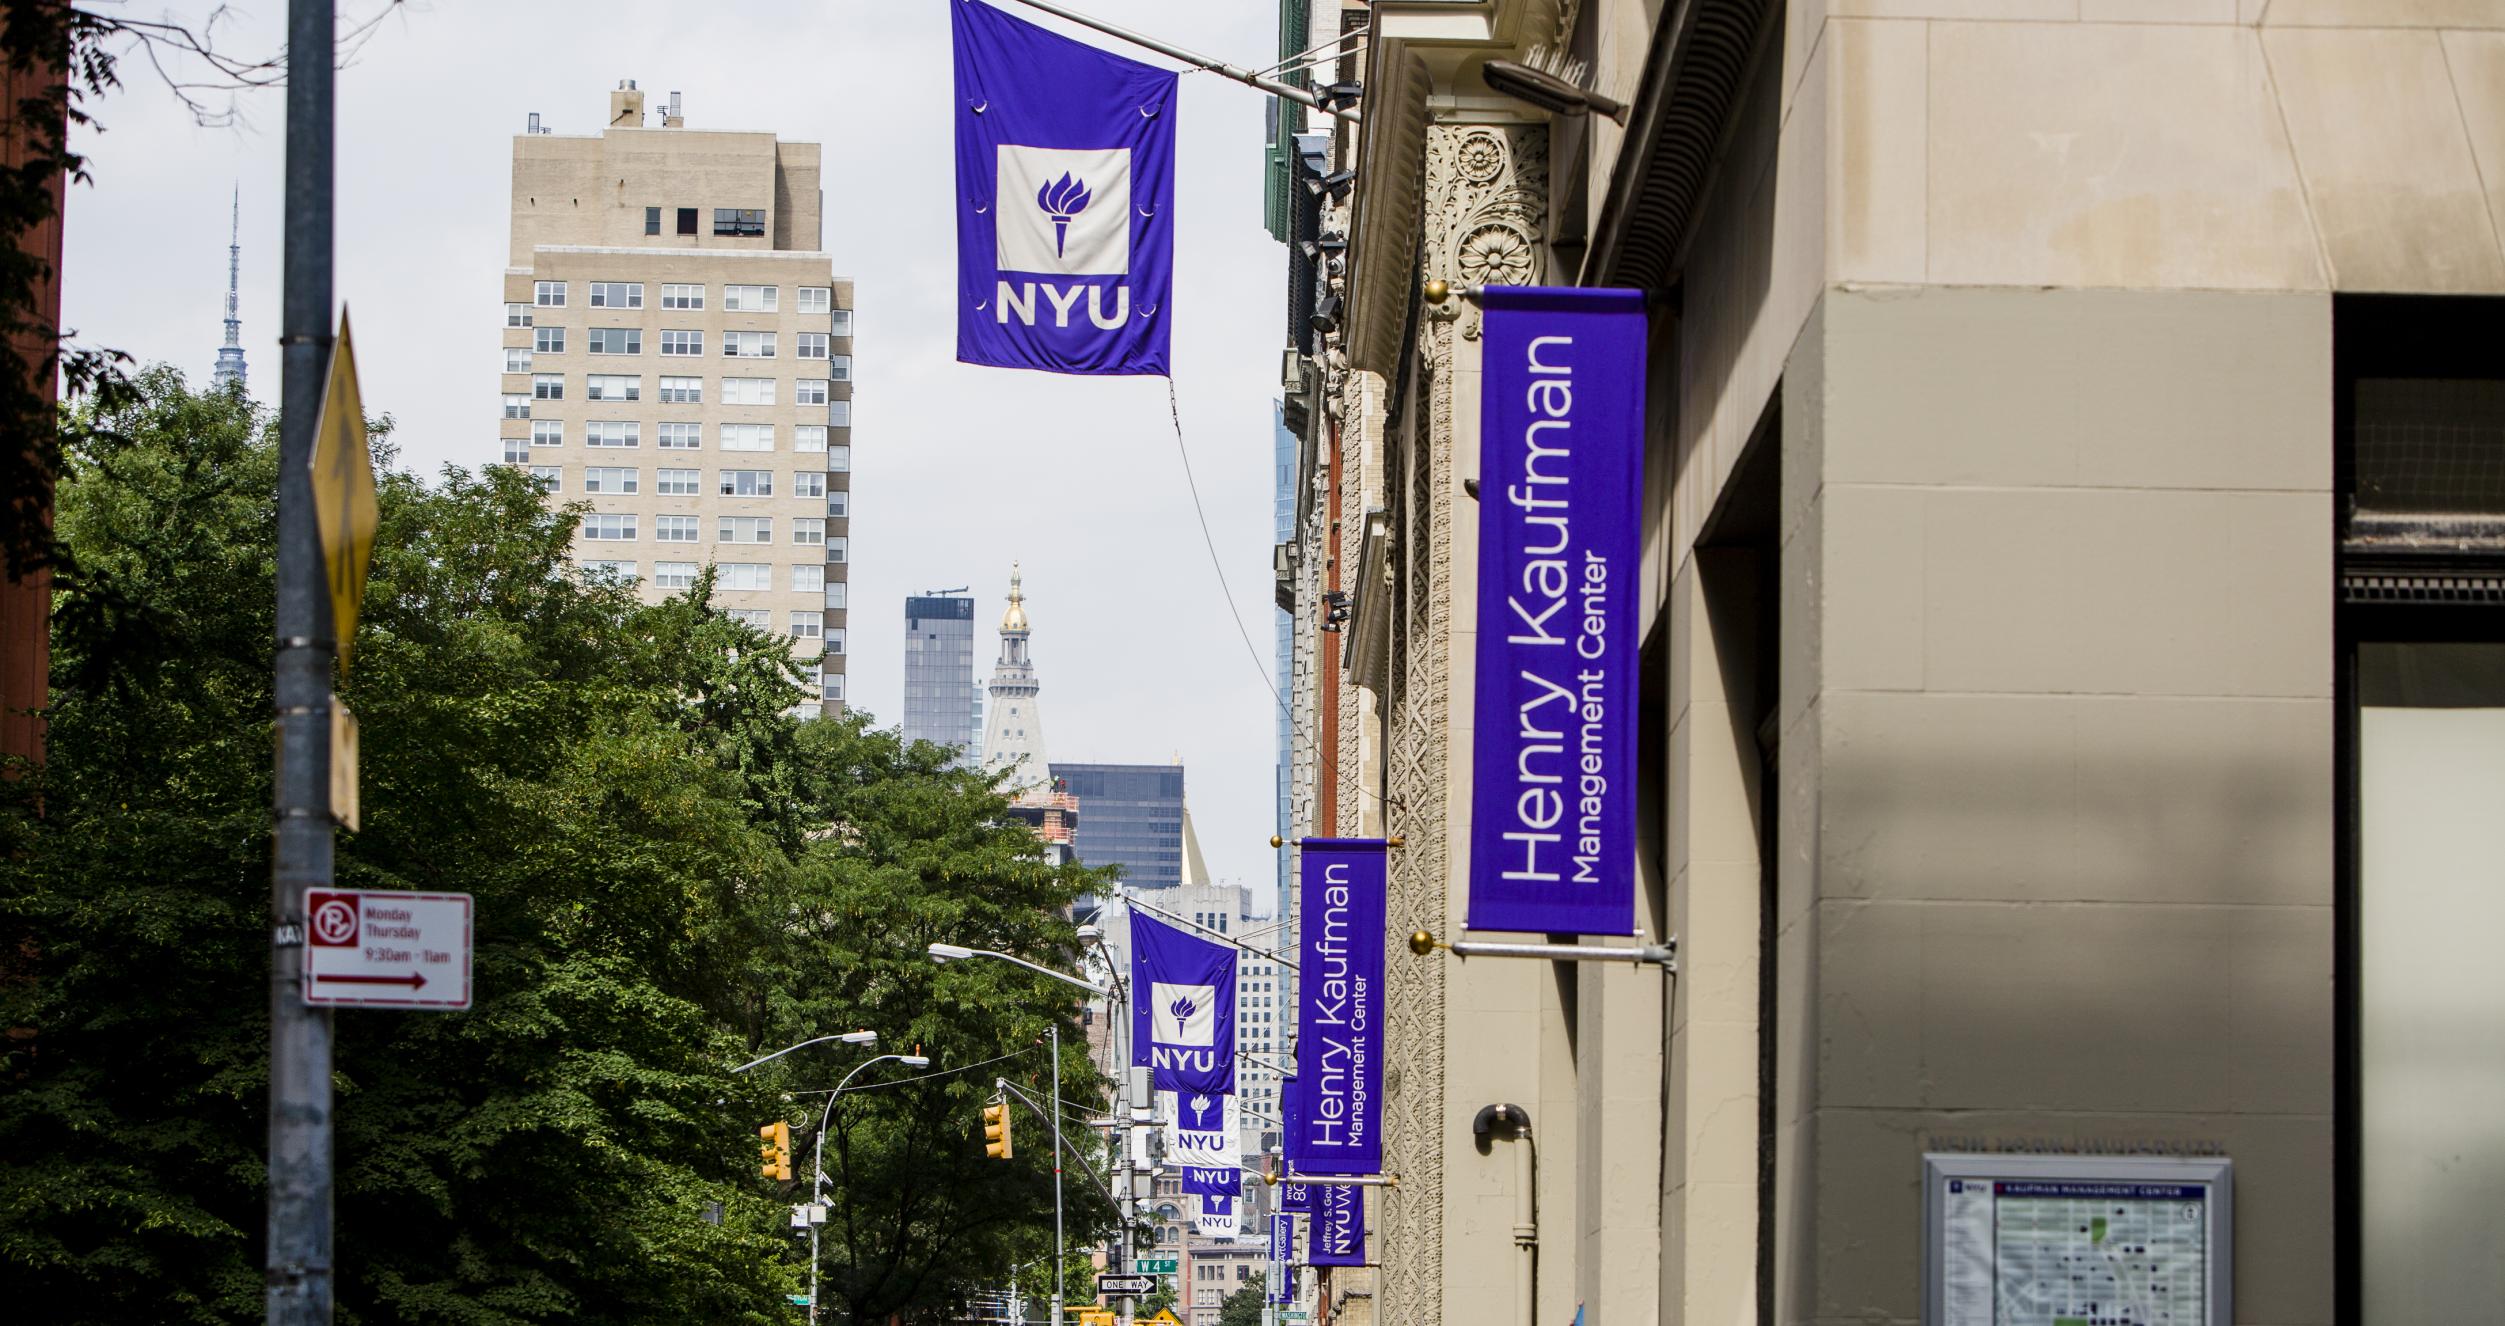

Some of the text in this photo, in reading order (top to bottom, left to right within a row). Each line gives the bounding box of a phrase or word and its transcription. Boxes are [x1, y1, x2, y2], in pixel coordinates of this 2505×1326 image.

[997, 280, 1130, 330] NYU
[1501, 335, 1577, 881] Henry Kaufman
[1572, 549, 1607, 883] Management Center
[365, 907, 413, 923] Monday
[366, 923, 422, 940] Thursday
[365, 949, 411, 963] 9:30am
[423, 949, 451, 964] 11am
[1312, 863, 1351, 1145] Henry Kaufman
[1152, 1046, 1215, 1073] NYU
[1348, 974, 1366, 1147] Management Center
[1178, 1133, 1224, 1151] NYU
[1193, 1168, 1230, 1184] NYU
[1202, 1217, 1233, 1228] NYU
[1323, 1183, 1333, 1254] Jeffrey S. Goul
[1141, 1262, 1149, 1272] W
[1153, 1261, 1160, 1272] 4
[1106, 1281, 1148, 1289] ONE WAY
